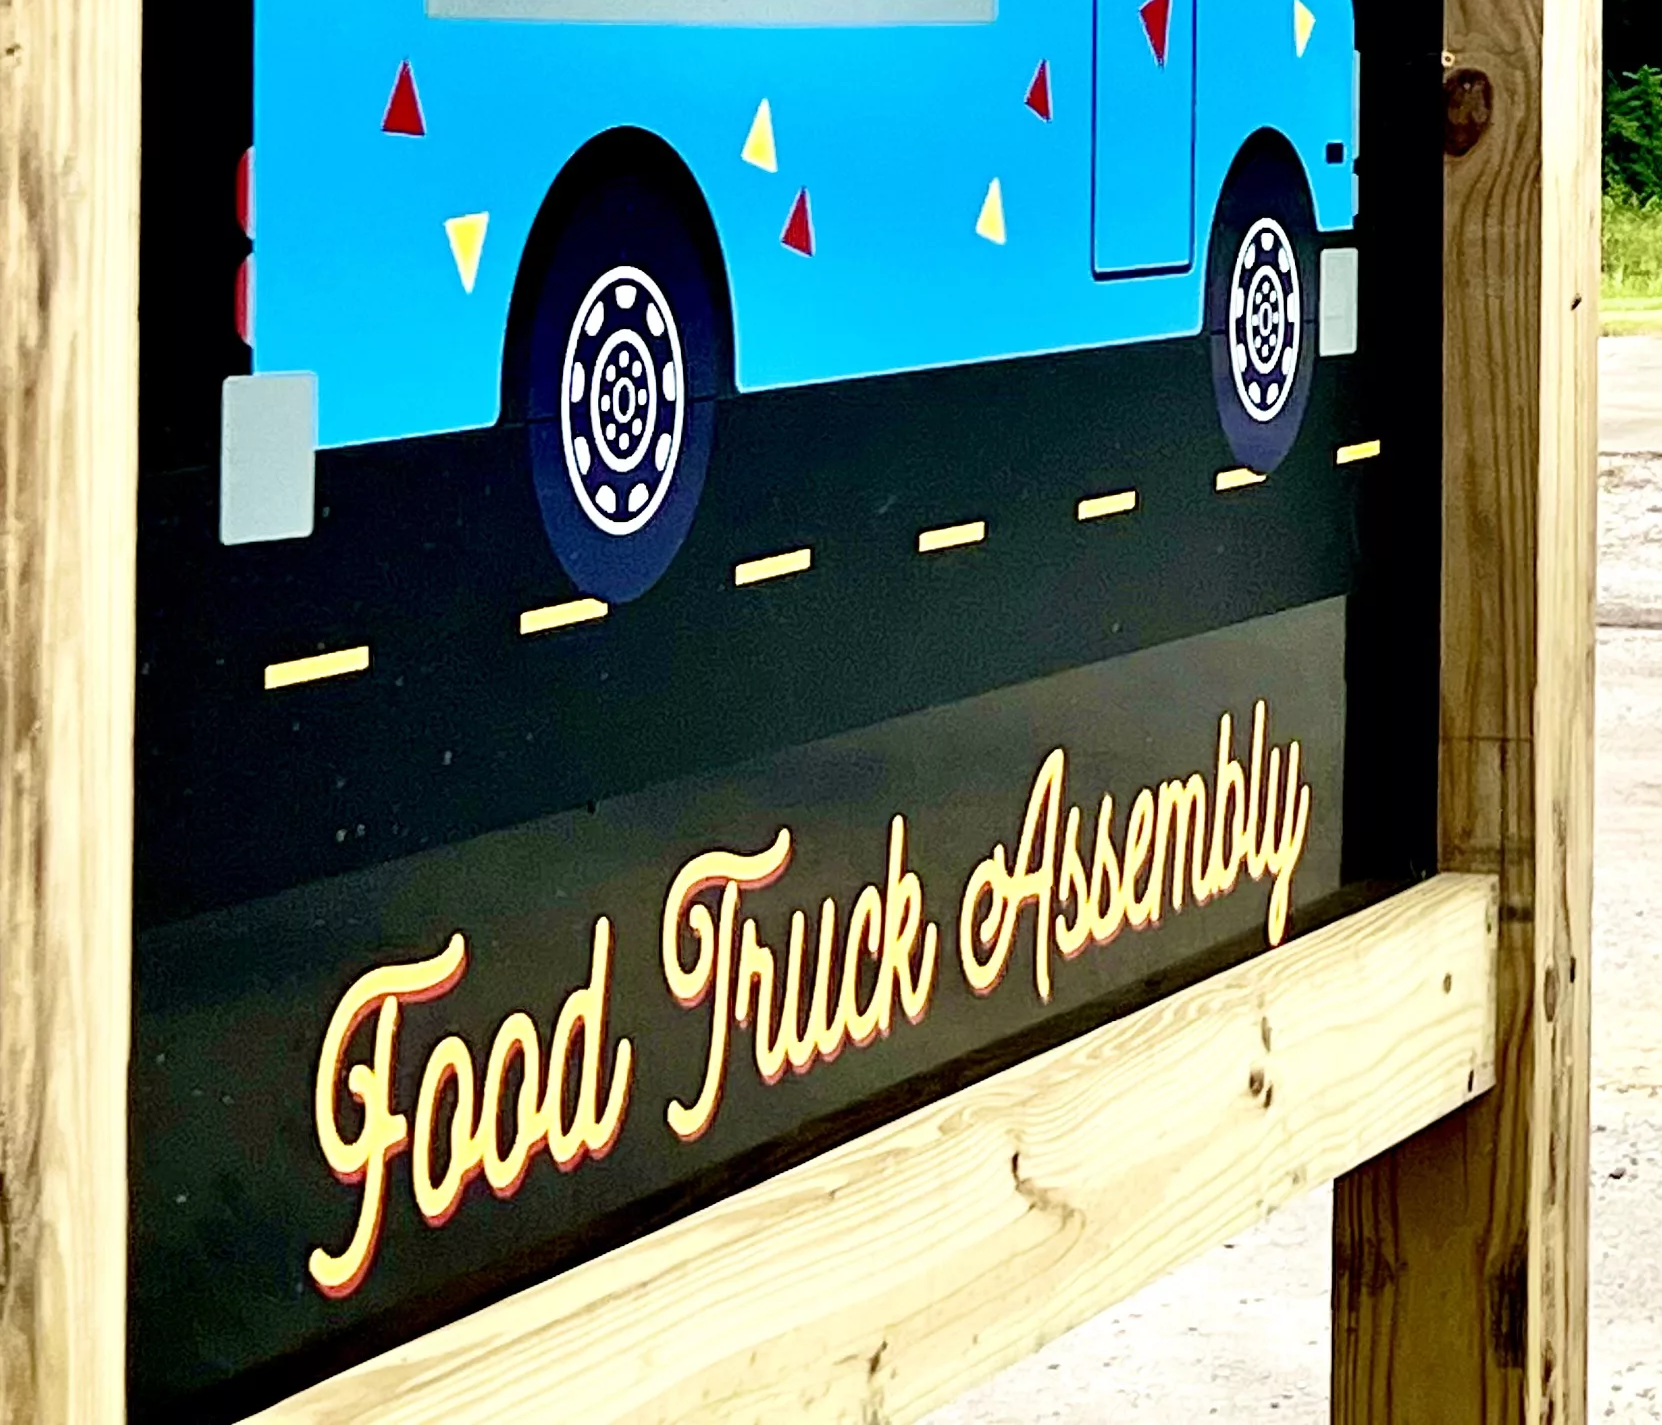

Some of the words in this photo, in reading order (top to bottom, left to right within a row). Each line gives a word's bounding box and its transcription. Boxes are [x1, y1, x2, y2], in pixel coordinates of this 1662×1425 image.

[309, 914, 633, 1298] Food
[663, 814, 937, 1142] Truck
[960, 699, 1310, 1002] Assembly
